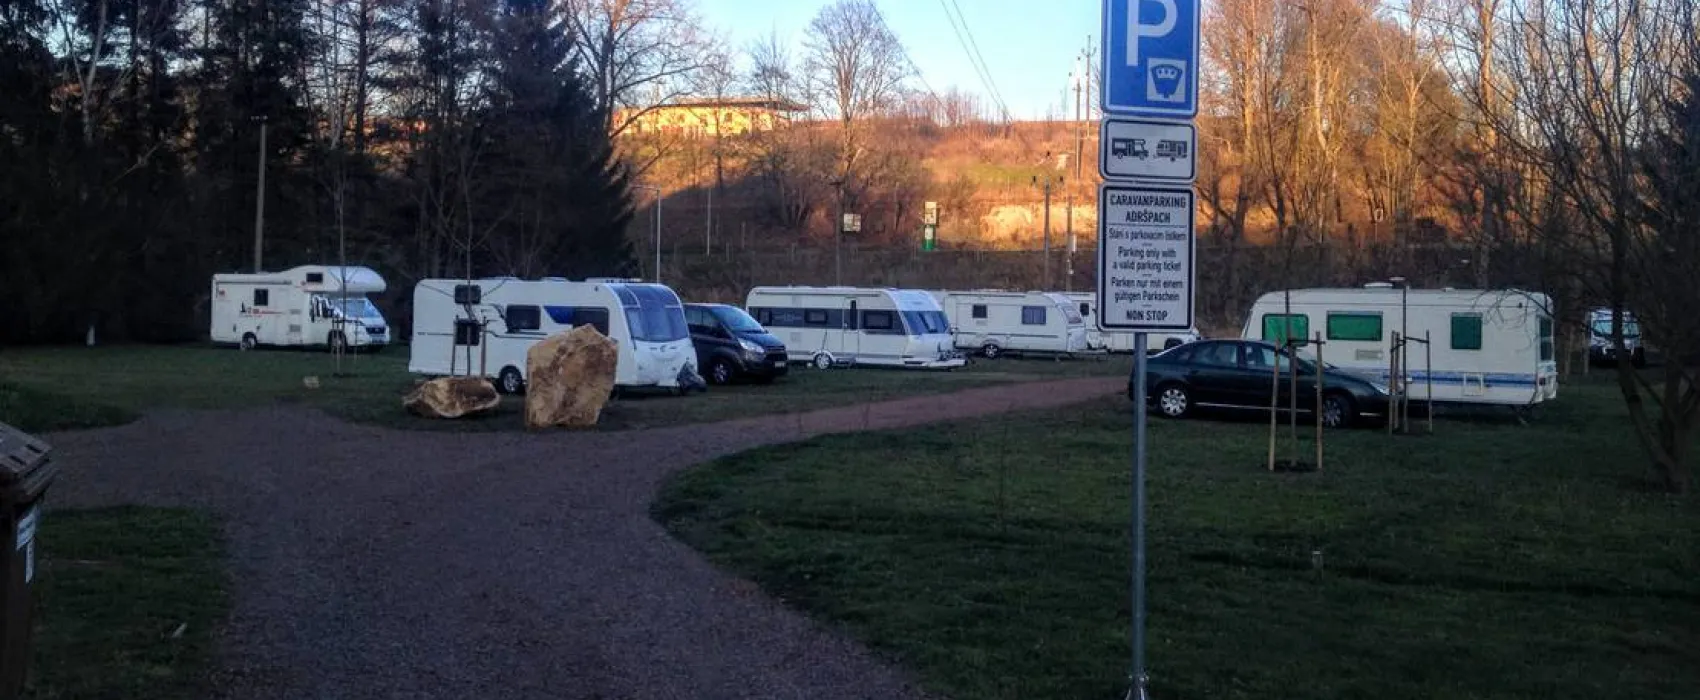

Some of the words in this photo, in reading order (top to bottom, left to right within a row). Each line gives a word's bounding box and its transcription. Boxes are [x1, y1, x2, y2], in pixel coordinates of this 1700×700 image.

[1126, 0, 1178, 66] P
[1110, 194, 1186, 208] CARAVANPARKING
[1126, 208, 1171, 223] ADRŠPACH
[1118, 246, 1144, 258] Parking
[1145, 247, 1160, 259] only
[1162, 247, 1176, 257] with
[1119, 260, 1135, 270] valid
[1136, 261, 1161, 272] parking
[1163, 261, 1181, 271] ticket
[1111, 277, 1135, 287] Parken
[1136, 279, 1147, 288] nur
[1150, 279, 1161, 288] mit
[1163, 279, 1183, 288] einem
[1142, 290, 1180, 301] Parkschein
[1126, 310, 1144, 320] NON
[1146, 310, 1168, 321] STOP
